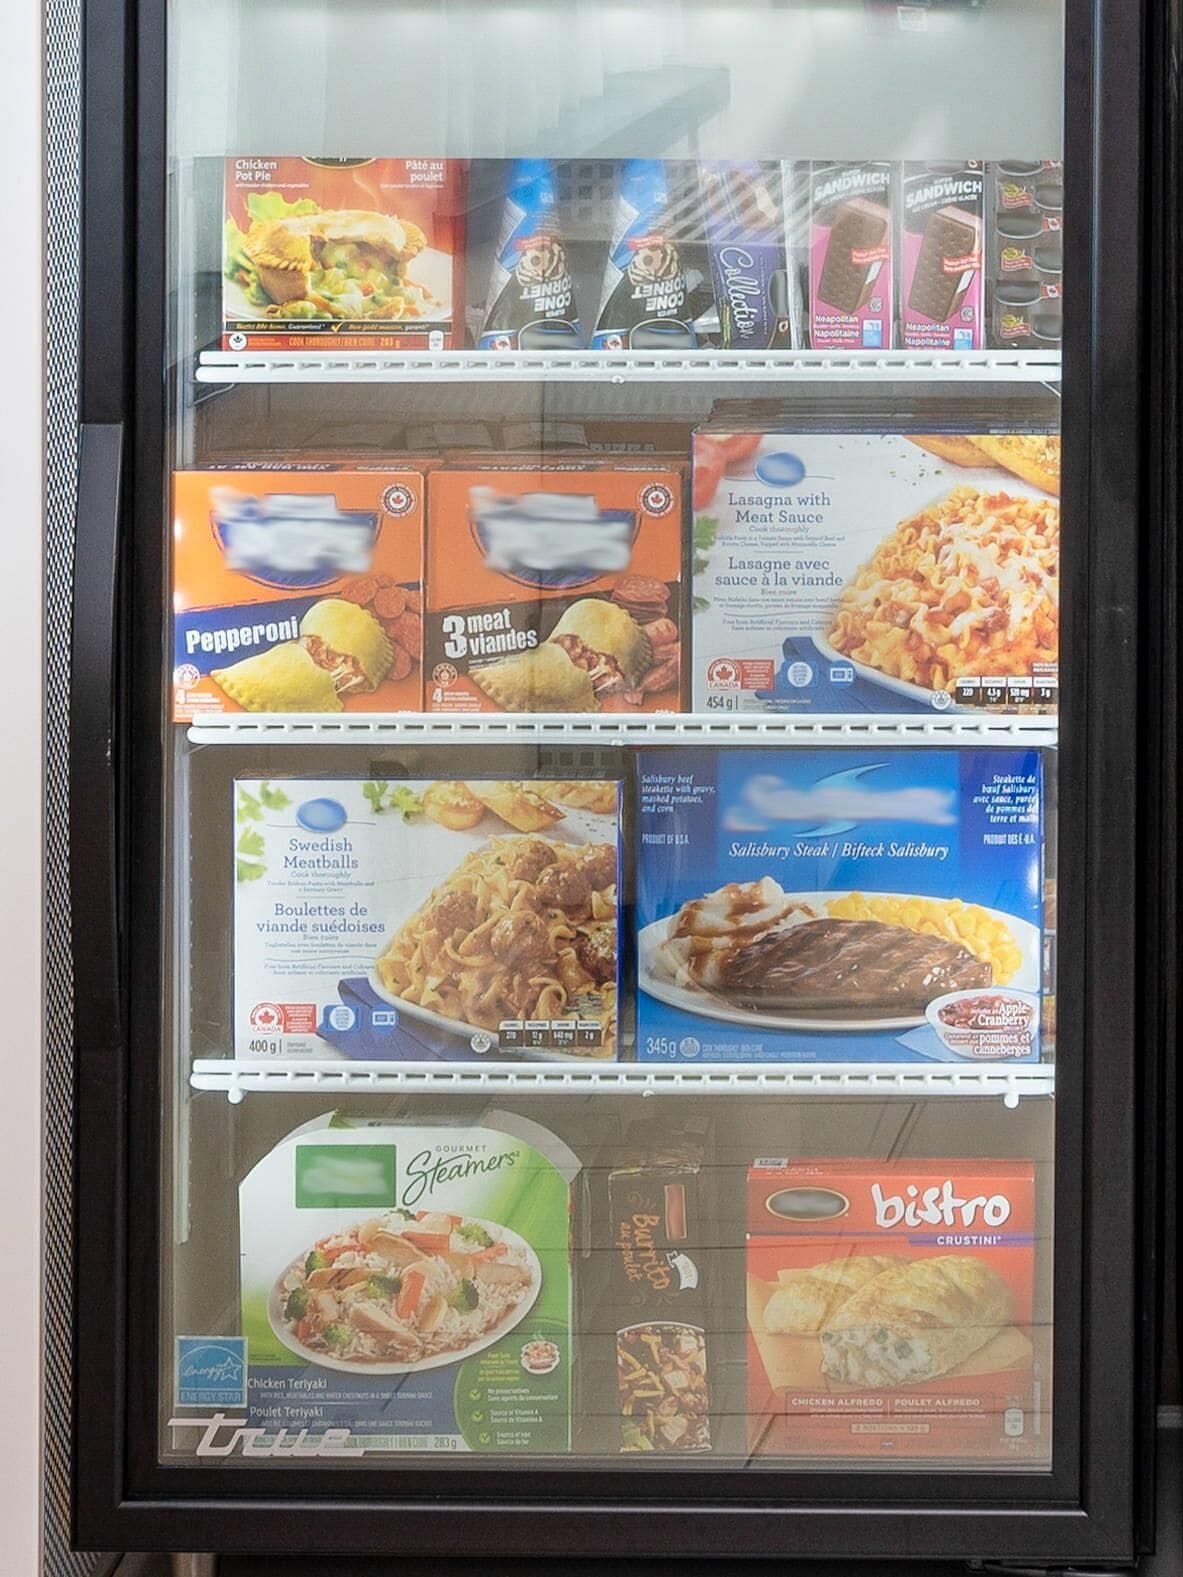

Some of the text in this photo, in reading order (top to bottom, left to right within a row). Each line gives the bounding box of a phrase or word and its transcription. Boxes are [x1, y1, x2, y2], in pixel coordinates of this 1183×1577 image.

[235, 159, 277, 170] Chicken
[405, 158, 444, 170] Pâté au
[235, 170, 272, 181] Pot Pie
[410, 170, 444, 182] poulet
[814, 172, 890, 201] SANDWICH
[906, 181, 982, 208] SANDWICH
[520, 274, 572, 299] CORNET
[631, 273, 686, 299] CORNET
[719, 246, 761, 341] Collection
[534, 293, 572, 312] CONE
[646, 292, 686, 312] CONE
[815, 316, 858, 324] Neapolitan
[814, 329, 860, 338] Napolitaine
[906, 323, 950, 332] Neapolitan
[904, 337, 950, 346] Napolitaine
[728, 492, 831, 509] Lasagna with
[736, 510, 824, 523] Meat Sauce
[728, 556, 830, 573] Lasagne avec
[715, 572, 844, 586] sauce à la viande
[186, 616, 298, 655] Pepperoni
[442, 608, 511, 659] 3 meat
[469, 628, 538, 656] viandes
[432, 688, 442, 702] 4
[706, 696, 732, 711] 454 g
[642, 774, 694, 784] Salisbury beef
[1026, 774, 1036, 784] de
[676, 784, 691, 793] with
[972, 796, 990, 804] avec
[642, 804, 656, 812] and
[289, 838, 353, 852] Swedish
[728, 842, 790, 860] Salisbury
[793, 842, 828, 856] Steak
[841, 842, 884, 860] Bifteck
[888, 842, 949, 860] Salisbury
[284, 855, 359, 869] Meatballs
[274, 902, 368, 916] Boulettes de
[256, 919, 386, 933] viande suédoises
[999, 1002, 1030, 1018] Apple-
[978, 1014, 1030, 1028] Cranberry
[980, 1032, 1030, 1046] pommes et
[249, 1040, 268, 1052] 400
[270, 1043, 276, 1054] g
[974, 1044, 1031, 1057] canneberges
[436, 1144, 487, 1152] GOURMET
[402, 1150, 516, 1206] Steamers
[871, 1180, 1010, 1228] bistro
[632, 1214, 671, 1290] Burrito
[247, 1378, 327, 1392] Chicken Teriyaki
[180, 1392, 241, 1401] ENERGY STAR
[792, 1398, 980, 1406] CHICKEN ALFREDO POULET ALFREDO
[250, 1406, 324, 1419] Poulet Teriyaki
[434, 1436, 457, 1450] 283 g
